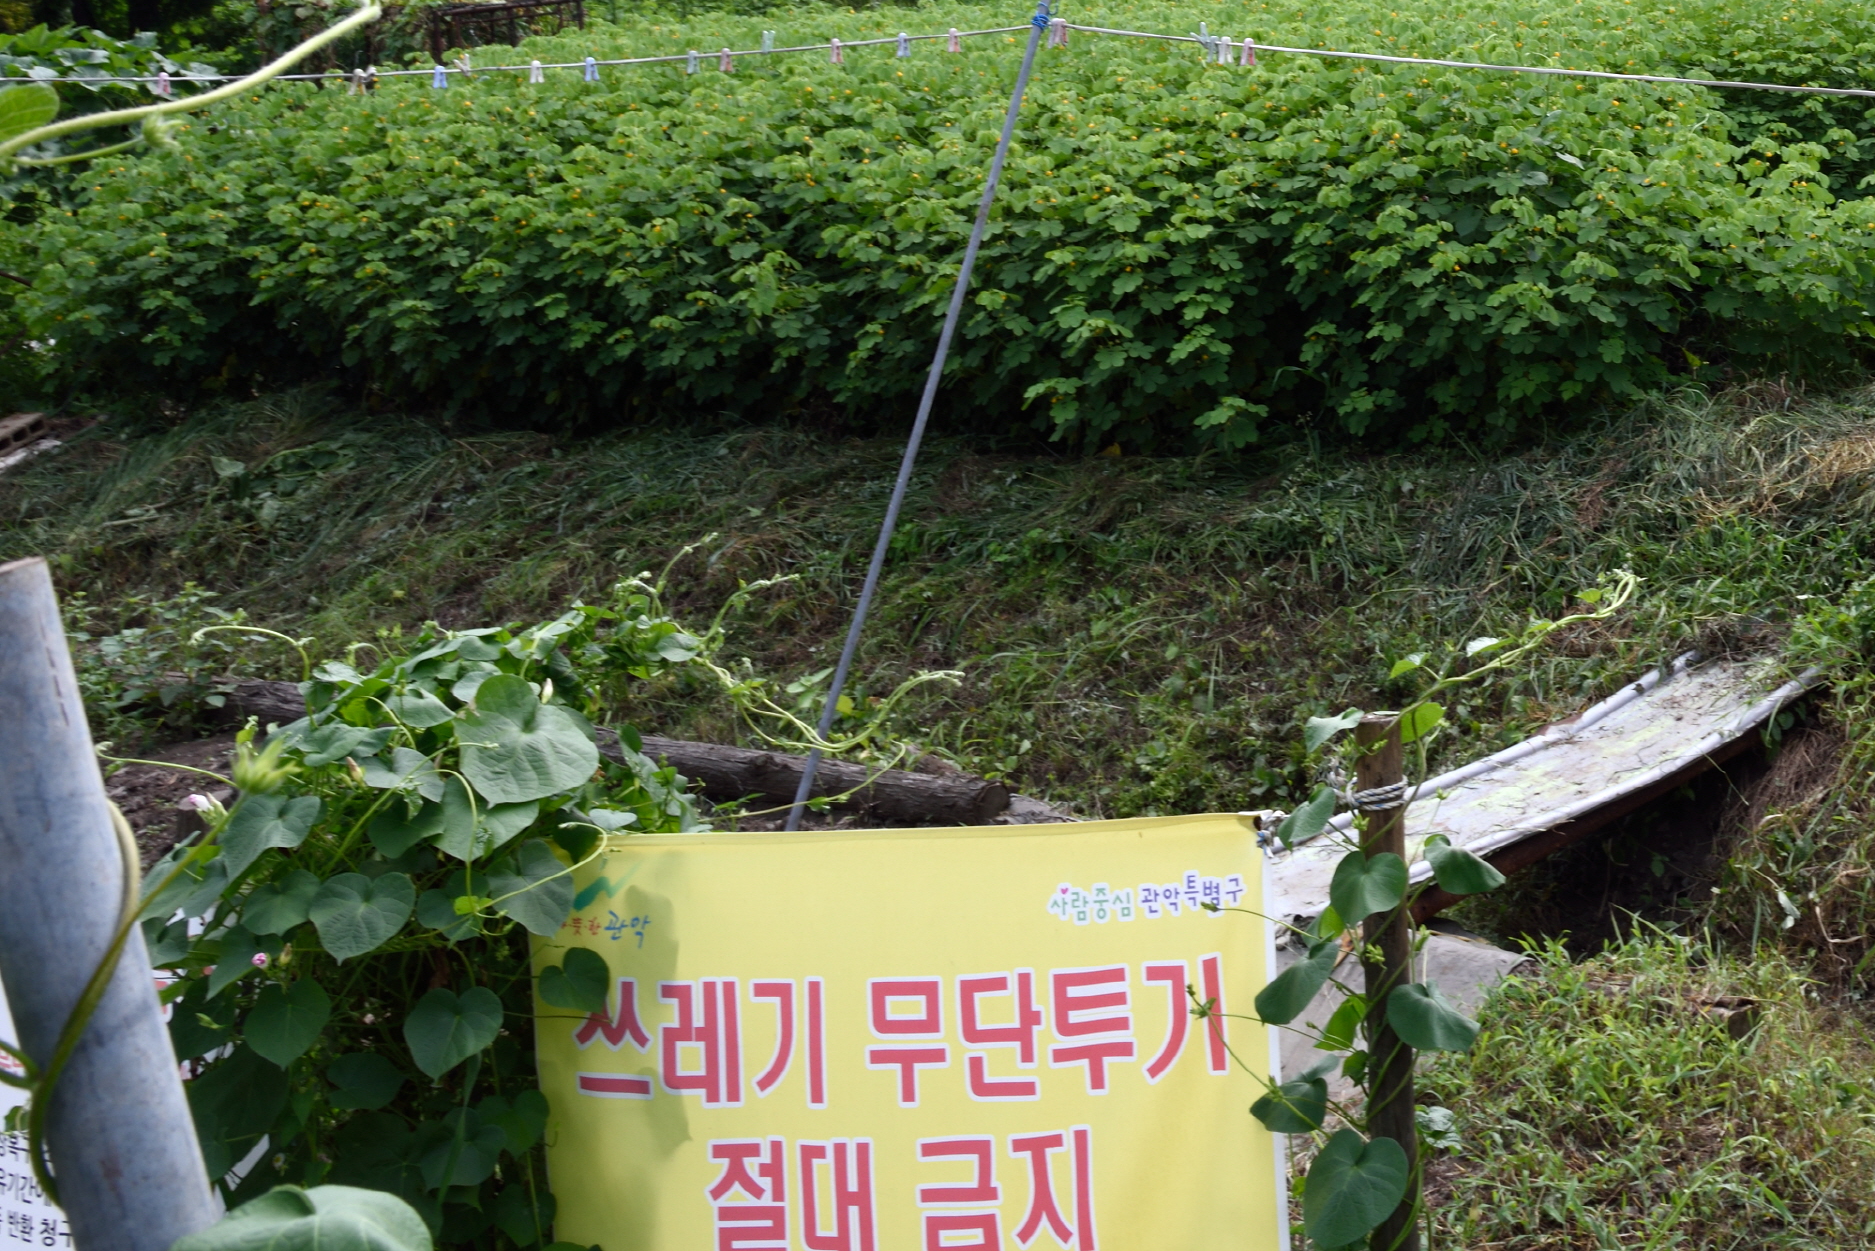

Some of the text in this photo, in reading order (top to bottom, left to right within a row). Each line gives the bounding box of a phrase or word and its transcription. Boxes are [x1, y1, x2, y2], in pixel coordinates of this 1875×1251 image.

[604, 910, 652, 948] 관악
[1050, 874, 1244, 922] 사람중심 관악특별구
[574, 956, 1228, 1105] 쓰레기 무단투기
[707, 1128, 1096, 1251] 절대 금지
